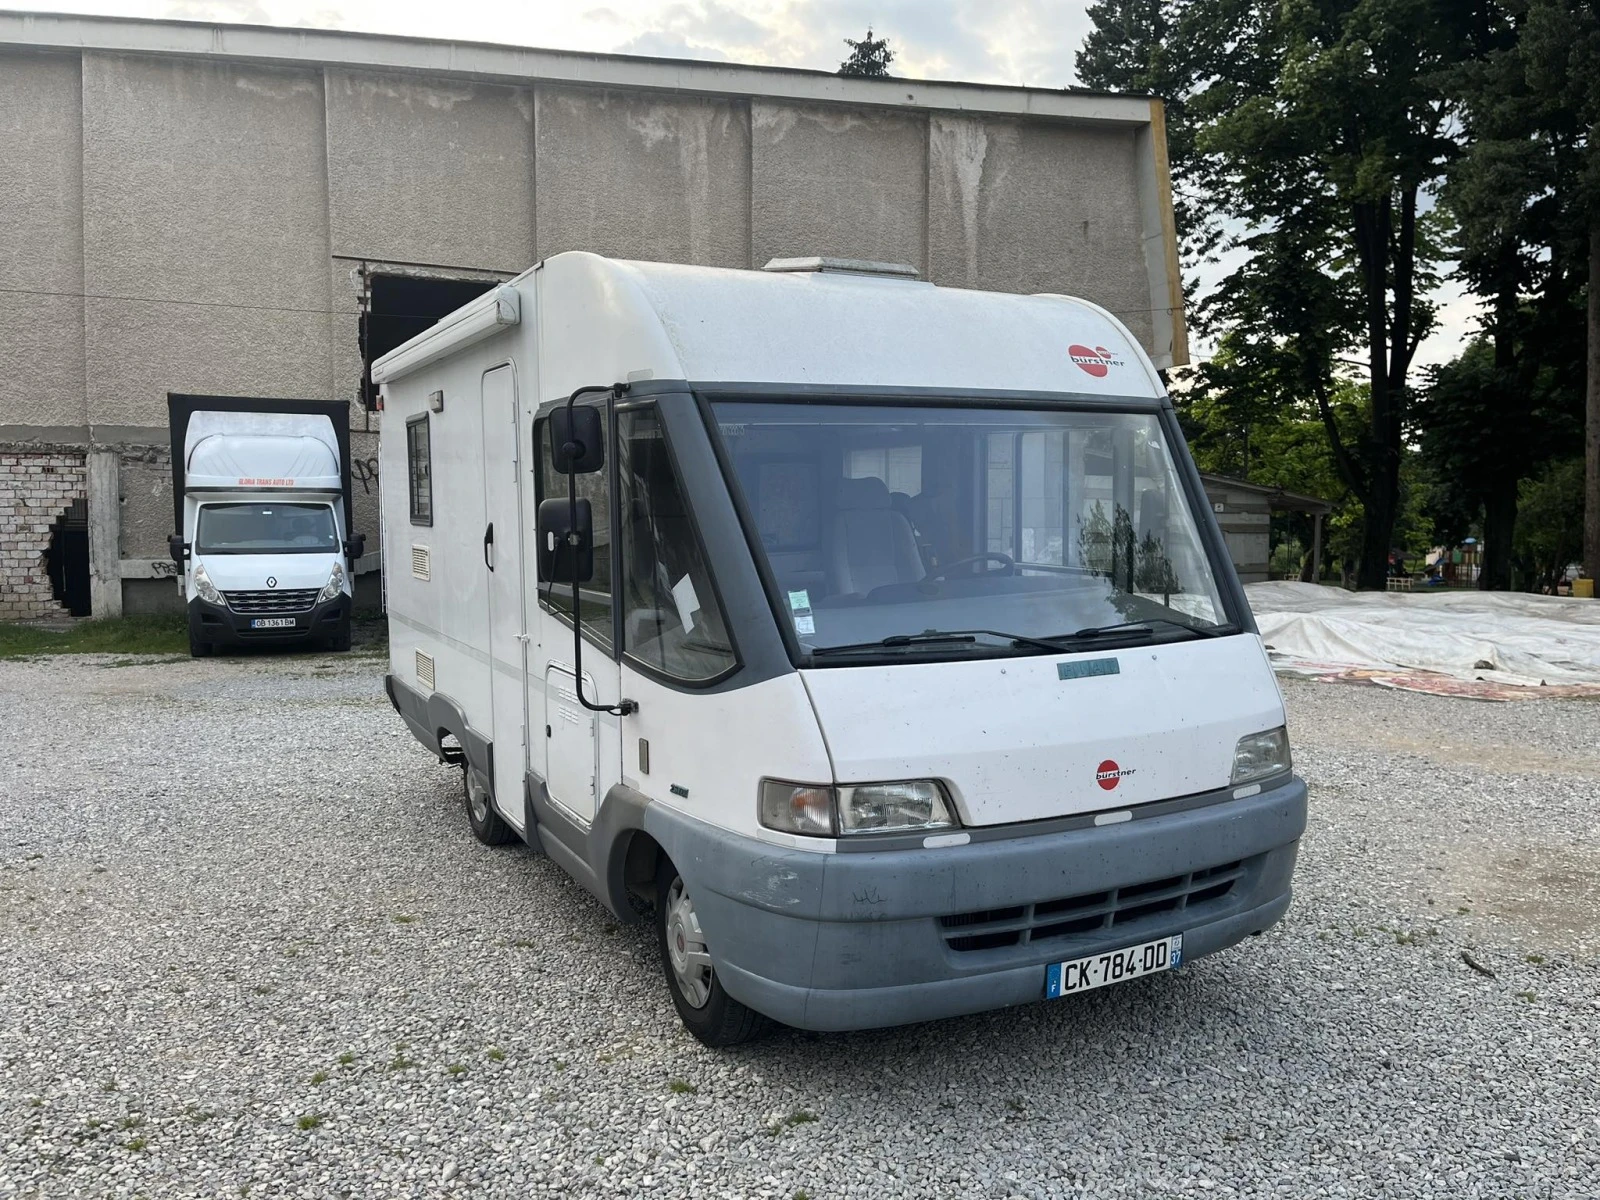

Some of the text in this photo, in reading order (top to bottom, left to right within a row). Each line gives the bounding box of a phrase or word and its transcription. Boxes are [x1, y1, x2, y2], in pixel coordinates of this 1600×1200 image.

[1070, 356, 1125, 367] bürstner
[256, 478, 272, 486] TRANS
[1095, 768, 1137, 780] bürstner
[1170, 951, 1181, 965] 37
